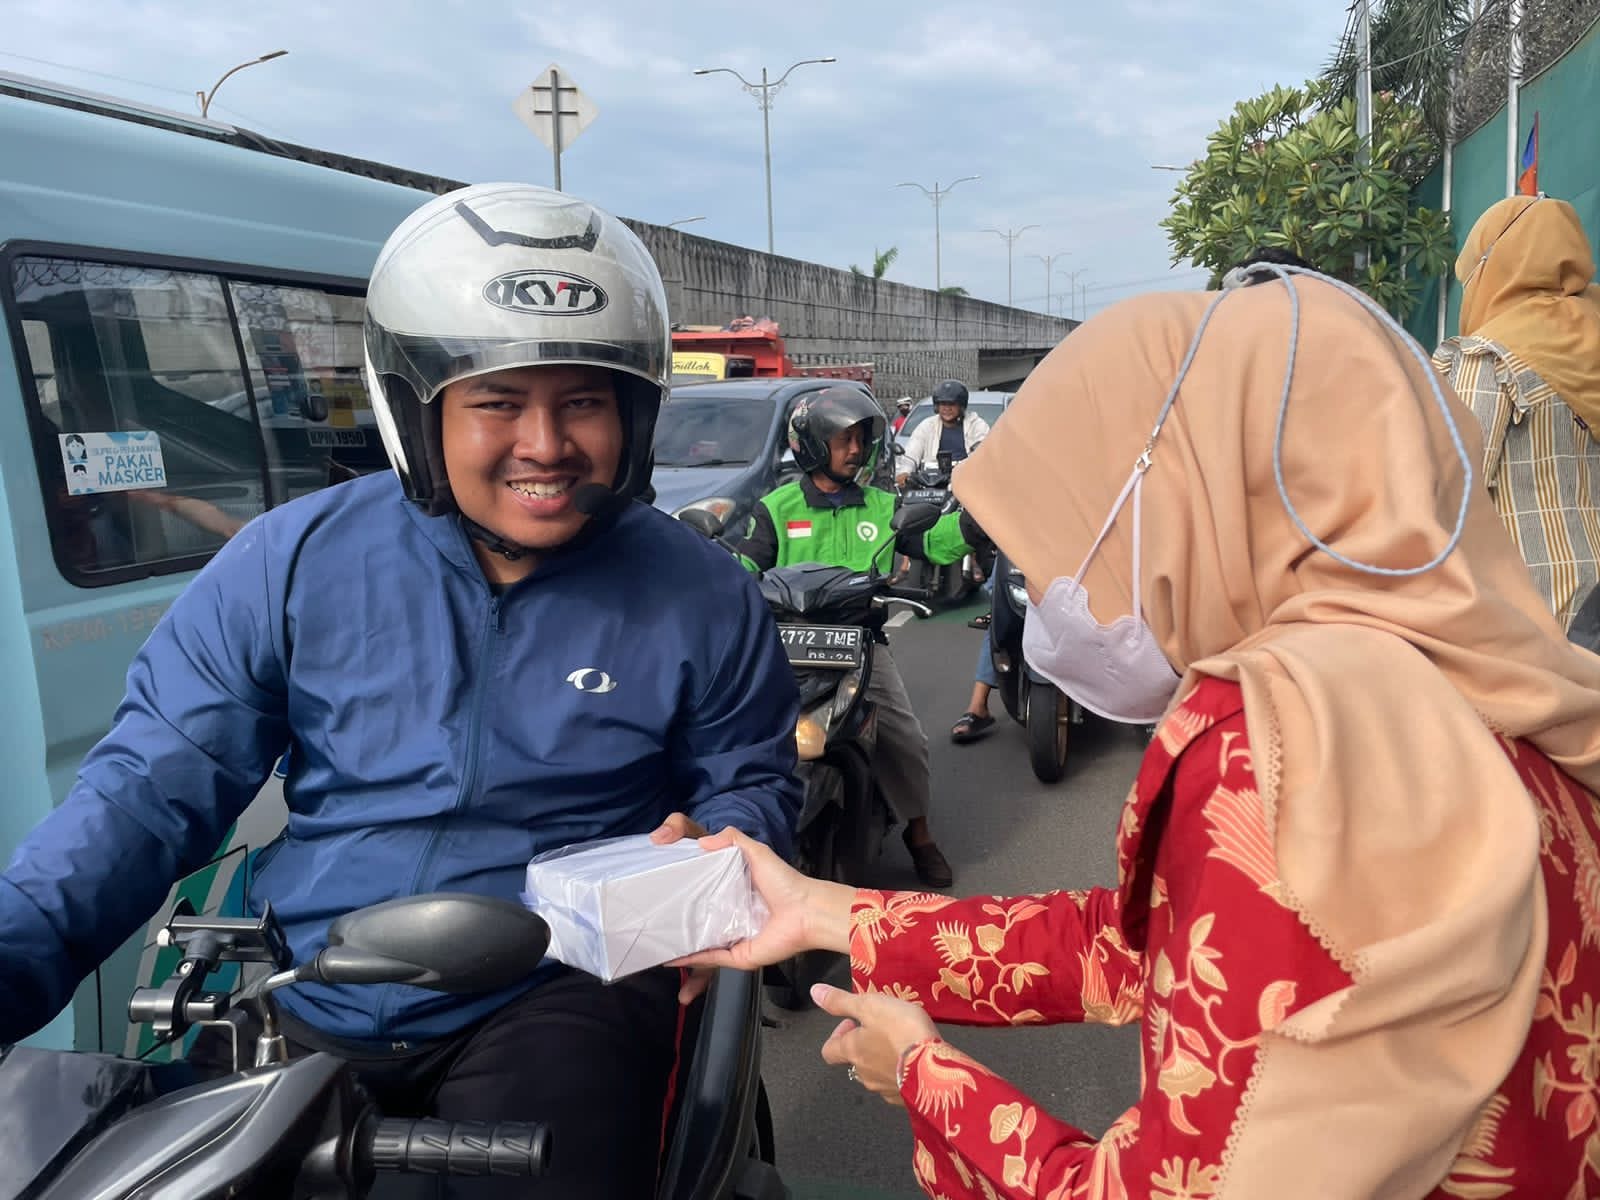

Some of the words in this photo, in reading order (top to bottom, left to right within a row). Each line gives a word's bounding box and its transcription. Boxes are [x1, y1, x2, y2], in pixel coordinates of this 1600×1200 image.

[489, 277, 601, 310] KYT
[104, 454, 153, 470] PAKAI
[98, 467, 165, 486] MASKER
[825, 631, 857, 647] TME
